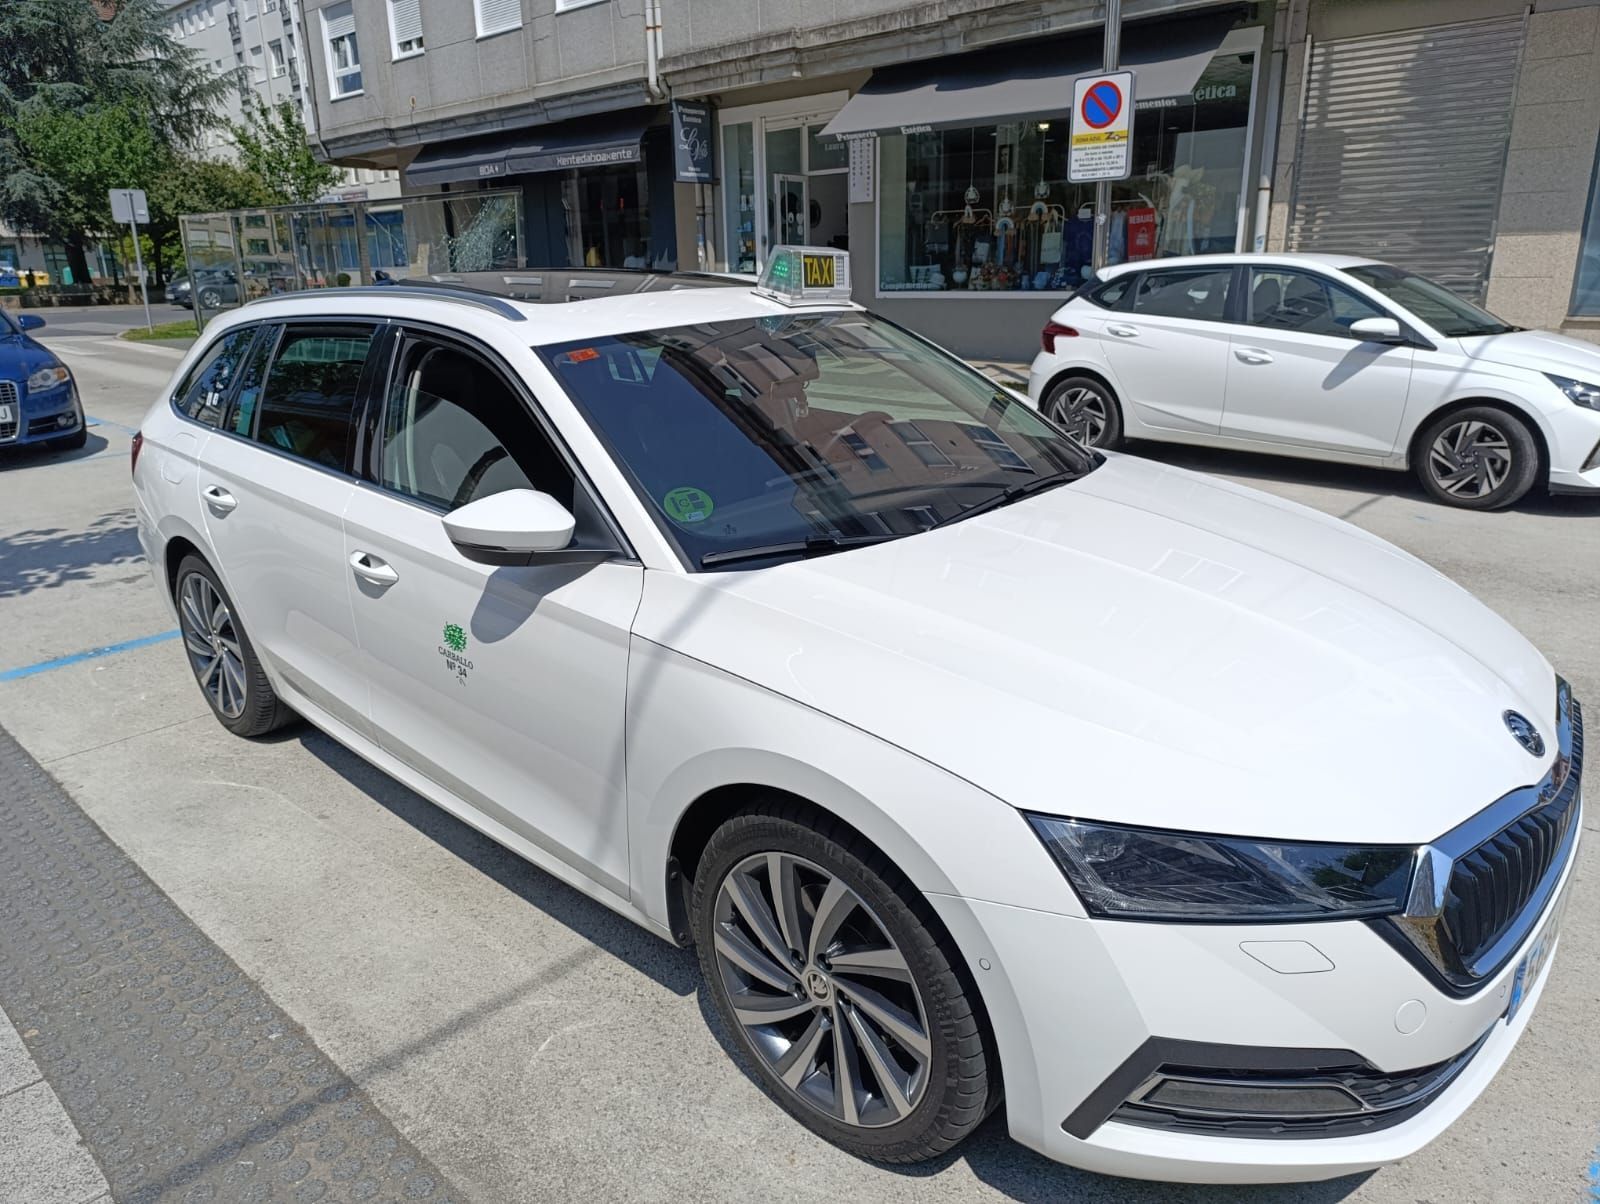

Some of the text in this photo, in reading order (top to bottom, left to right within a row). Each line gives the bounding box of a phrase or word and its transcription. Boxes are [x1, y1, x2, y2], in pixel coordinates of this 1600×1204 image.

[804, 257, 834, 286] TAXI
[438, 646, 474, 670] CARBALLO
[457, 665, 467, 678] 34
